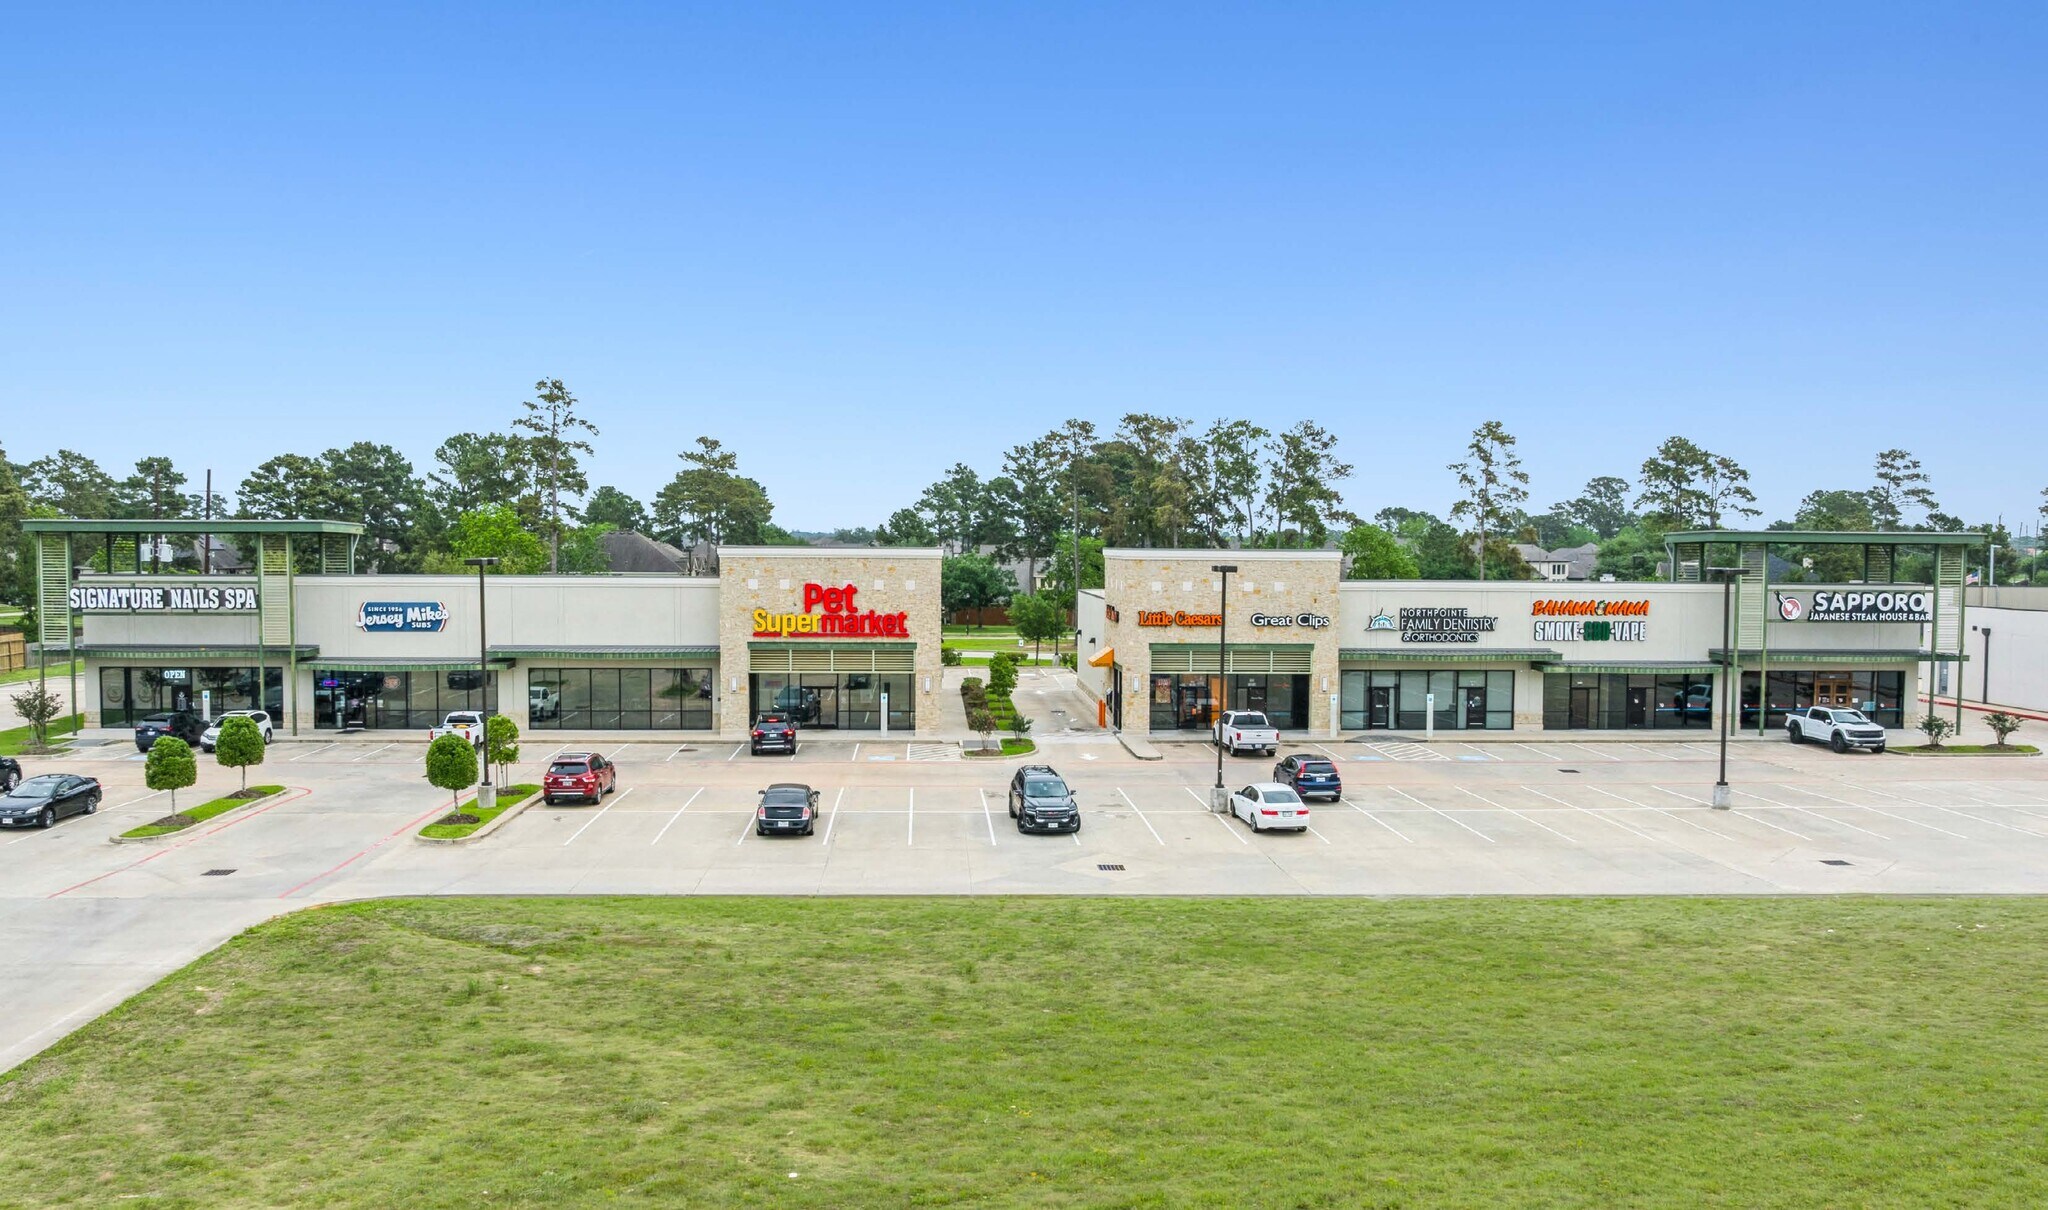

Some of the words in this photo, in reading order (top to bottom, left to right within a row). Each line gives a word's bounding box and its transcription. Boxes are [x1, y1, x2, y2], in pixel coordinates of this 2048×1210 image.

[70, 587, 164, 609] SIGNATURE
[170, 588, 220, 609] NAILS
[224, 588, 257, 609] SPA
[804, 583, 859, 614] Pet
[1814, 592, 1926, 612] SAPPORO
[1401, 609, 1468, 617] NORTHPOINTE
[1532, 599, 1596, 616] BAHAMA
[1604, 599, 1650, 616] MAMA
[355, 612, 404, 628] Jersey
[406, 606, 450, 622] Mike's
[752, 608, 908, 637] Supermarket
[1139, 611, 1173, 626] Little
[1175, 611, 1222, 626] Caesars
[1251, 614, 1292, 627] Great
[1296, 614, 1330, 629] Clips
[1401, 618, 1443, 630] FAMILY
[1443, 618, 1498, 630] DENTISTRY
[1809, 612, 1850, 621] JAPANESE
[1851, 612, 1878, 621] STEAK
[1879, 612, 1908, 621] HOUSE
[1411, 633, 1480, 641] ORTHODONTICS
[1534, 621, 1580, 641] SMOKE
[1613, 621, 1646, 641] VAPE
[164, 670, 186, 679] OPEN
